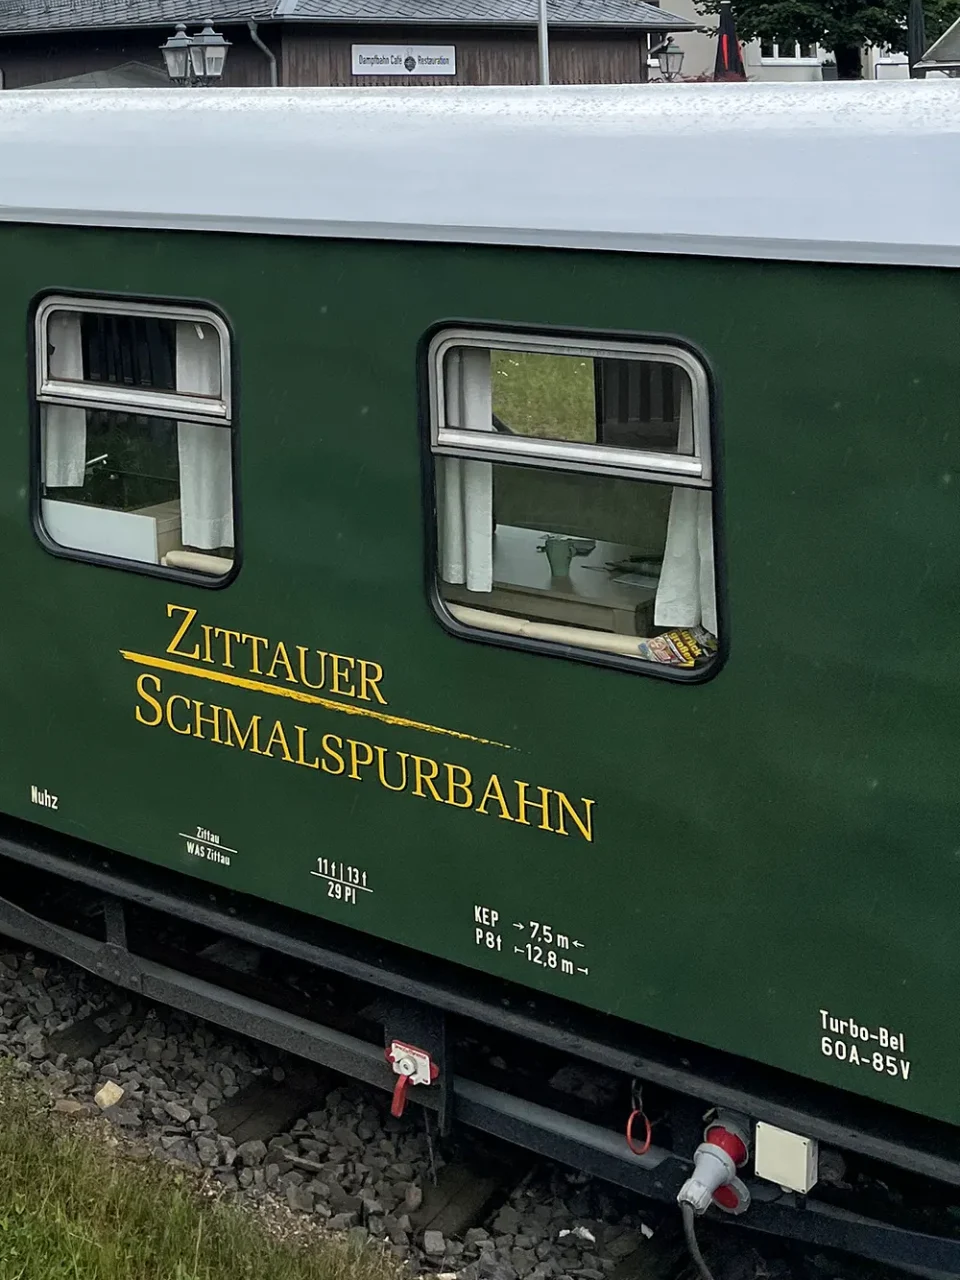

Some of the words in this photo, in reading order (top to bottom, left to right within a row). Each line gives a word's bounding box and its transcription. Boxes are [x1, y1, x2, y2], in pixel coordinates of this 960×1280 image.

[358, 54, 390, 66] Dampfbahn
[417, 55, 450, 65] Restauration
[166, 603, 388, 706] ZITTAUER
[134, 673, 596, 843] SCHMALSPURBAHN
[31, 785, 59, 810] Nuhz
[196, 826, 220, 844] Zittau
[186, 841, 205, 858] WAS
[206, 847, 230, 866] Zittau
[327, 881, 342, 899] 29
[474, 905, 499, 927] KEP
[529, 921, 553, 944] 7,5
[557, 934, 570, 950] m
[525, 943, 557, 969] 12,8
[561, 959, 574, 975] m
[819, 1009, 905, 1053] Turbo-Bel
[821, 1036, 911, 1080] 60A-85V
